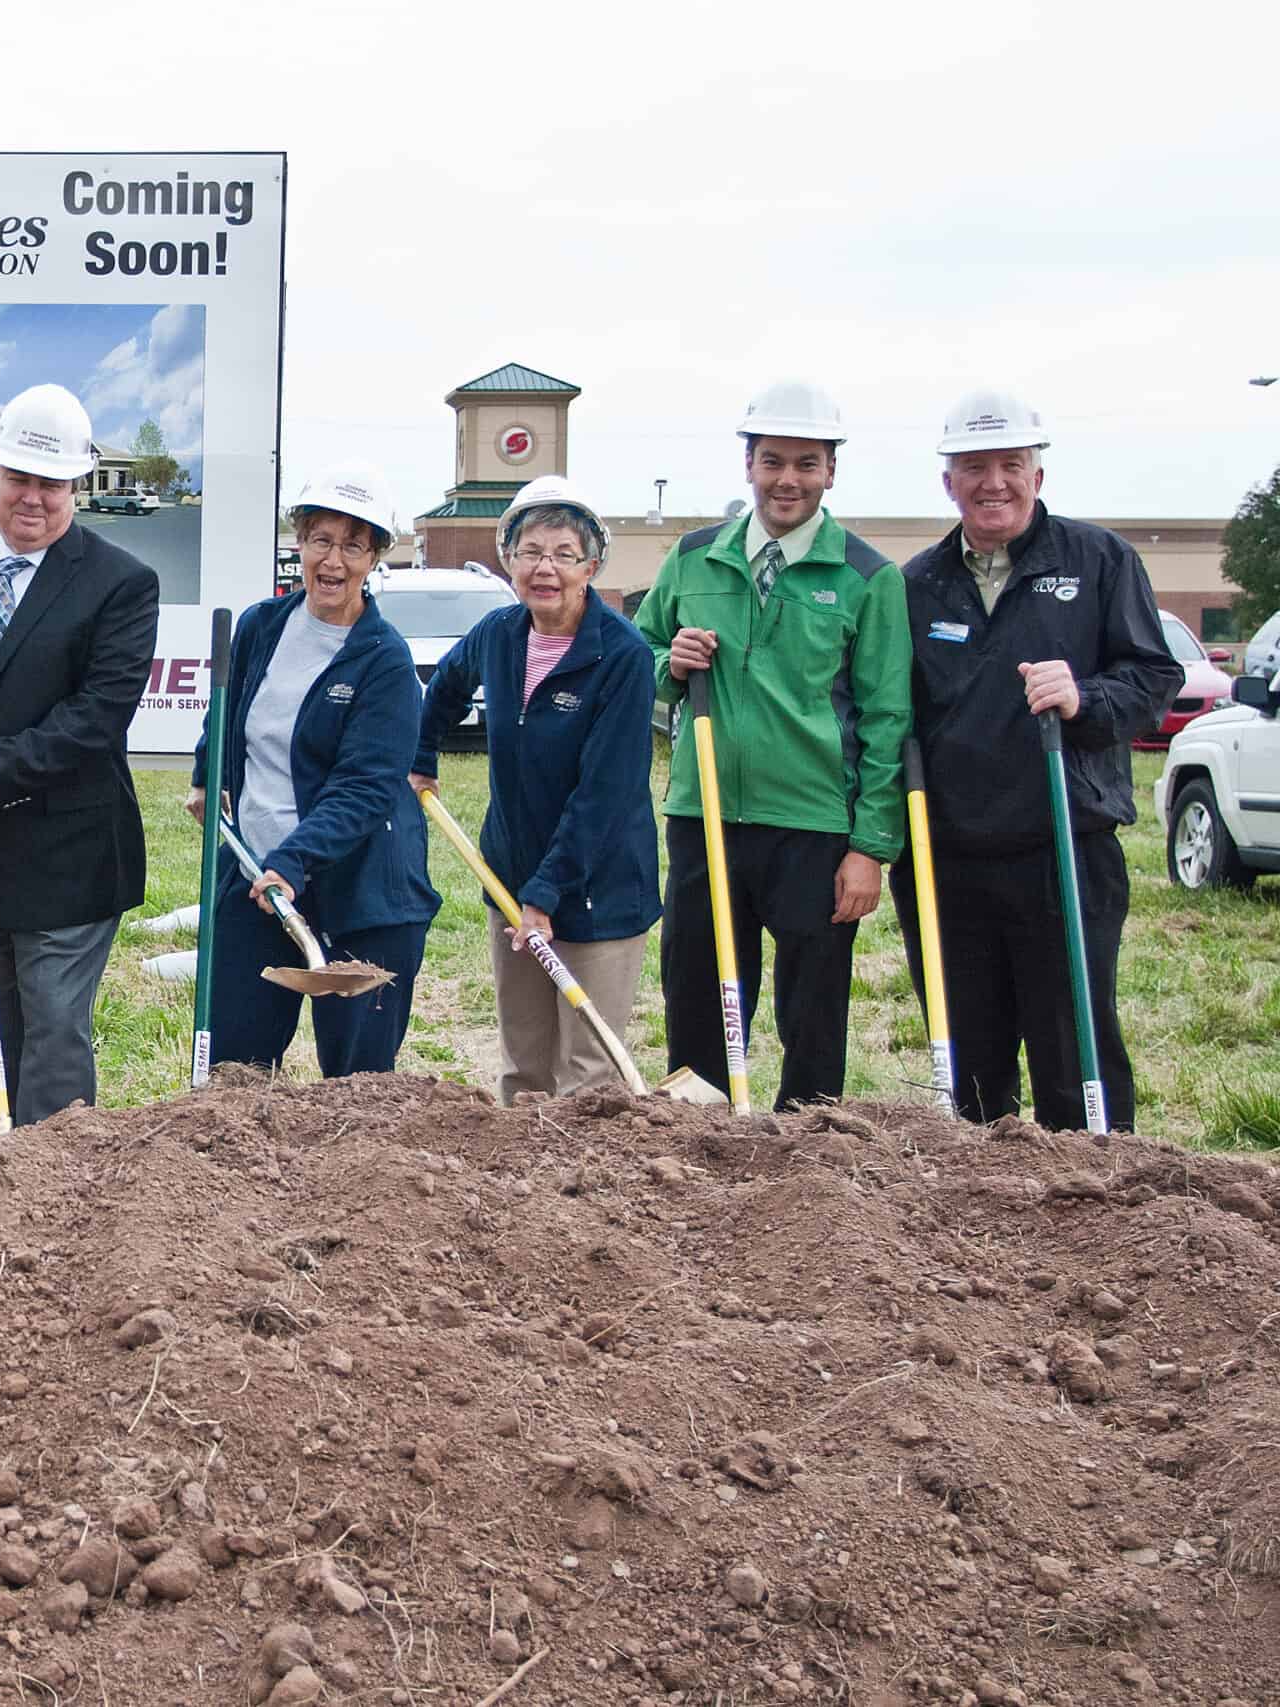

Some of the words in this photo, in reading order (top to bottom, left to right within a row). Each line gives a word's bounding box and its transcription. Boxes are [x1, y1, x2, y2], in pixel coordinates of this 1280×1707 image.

[63, 171, 253, 226] Coming
[85, 231, 227, 276] Soon!
[722, 982, 740, 1043] SMET
[198, 1033, 209, 1068] SMET
[930, 1042, 950, 1096] MET
[1086, 1084, 1097, 1117] SMET
